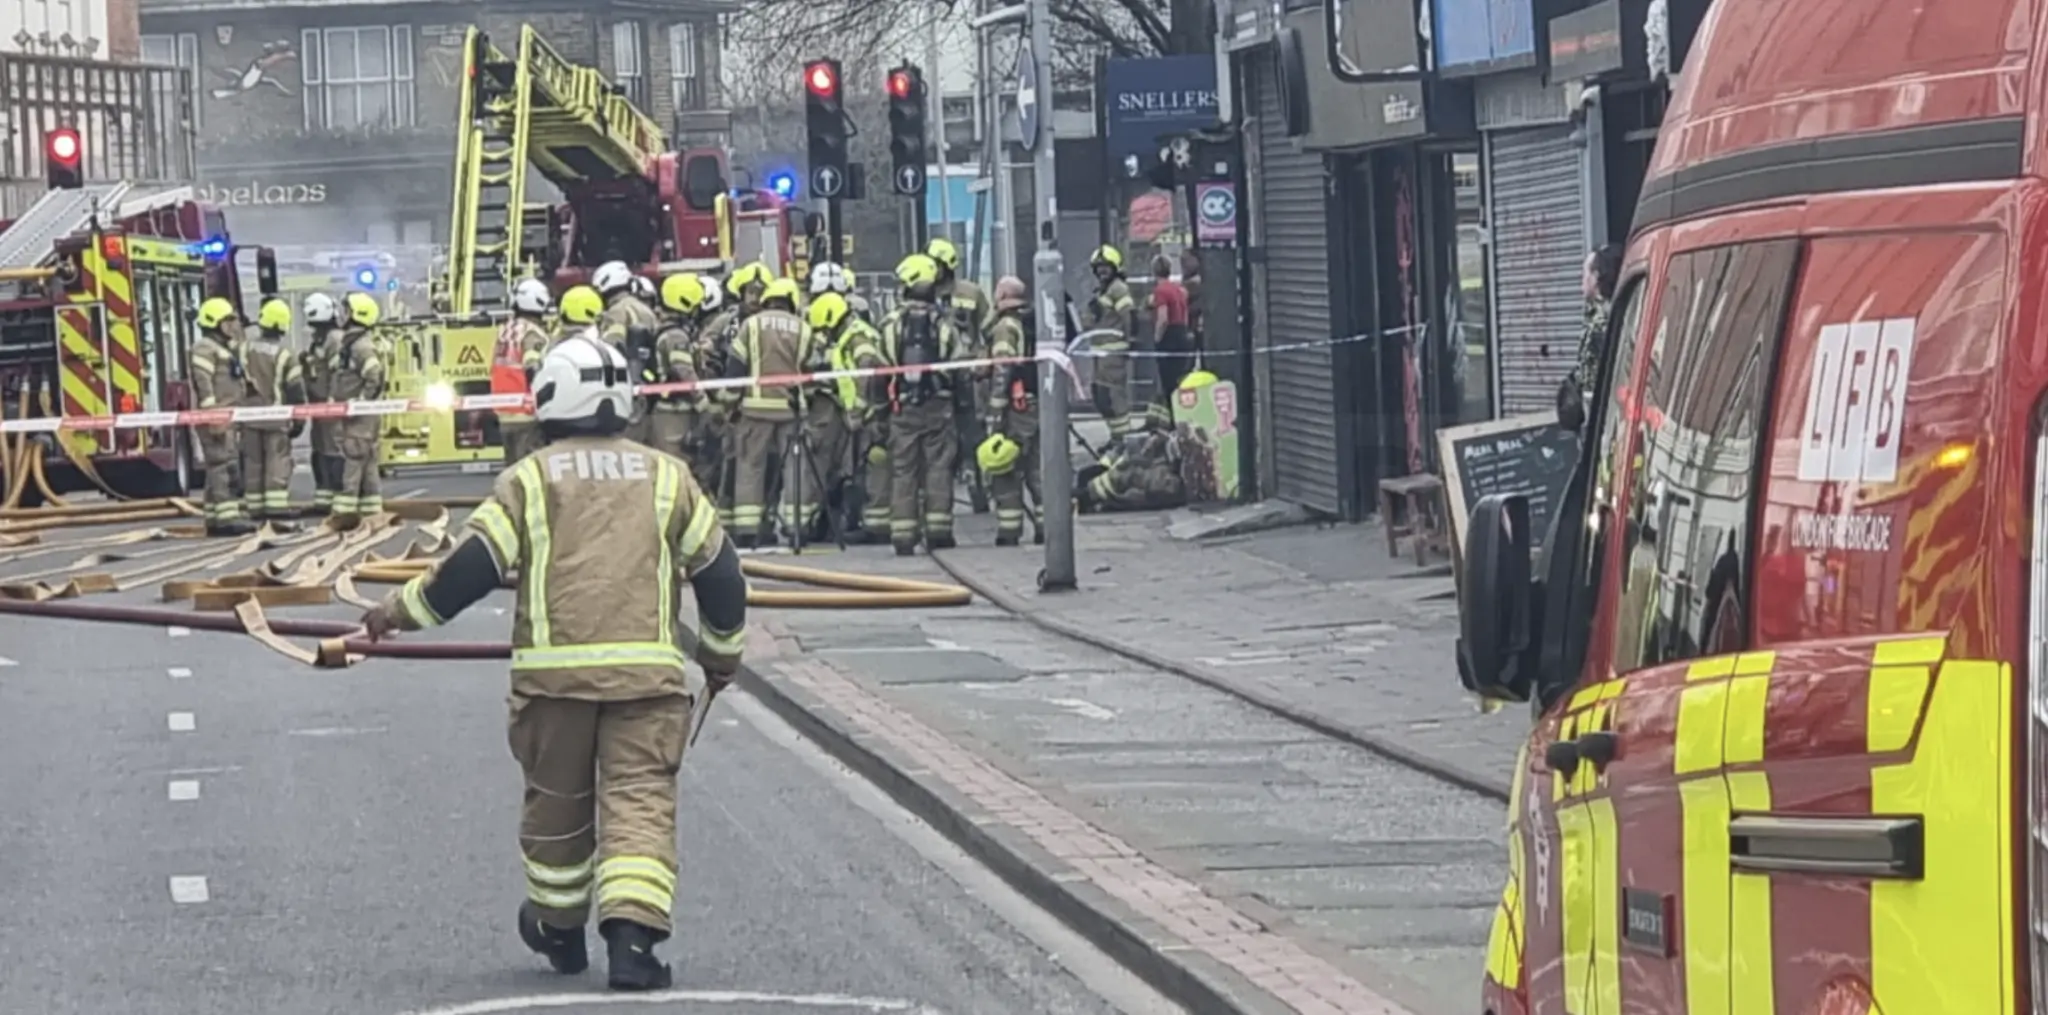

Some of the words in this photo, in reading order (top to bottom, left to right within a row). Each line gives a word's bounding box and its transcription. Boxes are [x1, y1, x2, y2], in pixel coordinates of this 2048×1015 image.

[1118, 90, 1219, 110] SNELLERS
[760, 316, 799, 333] FIRE
[548, 449, 648, 483] FIRE
[1847, 514, 1891, 551] BRIGADE
